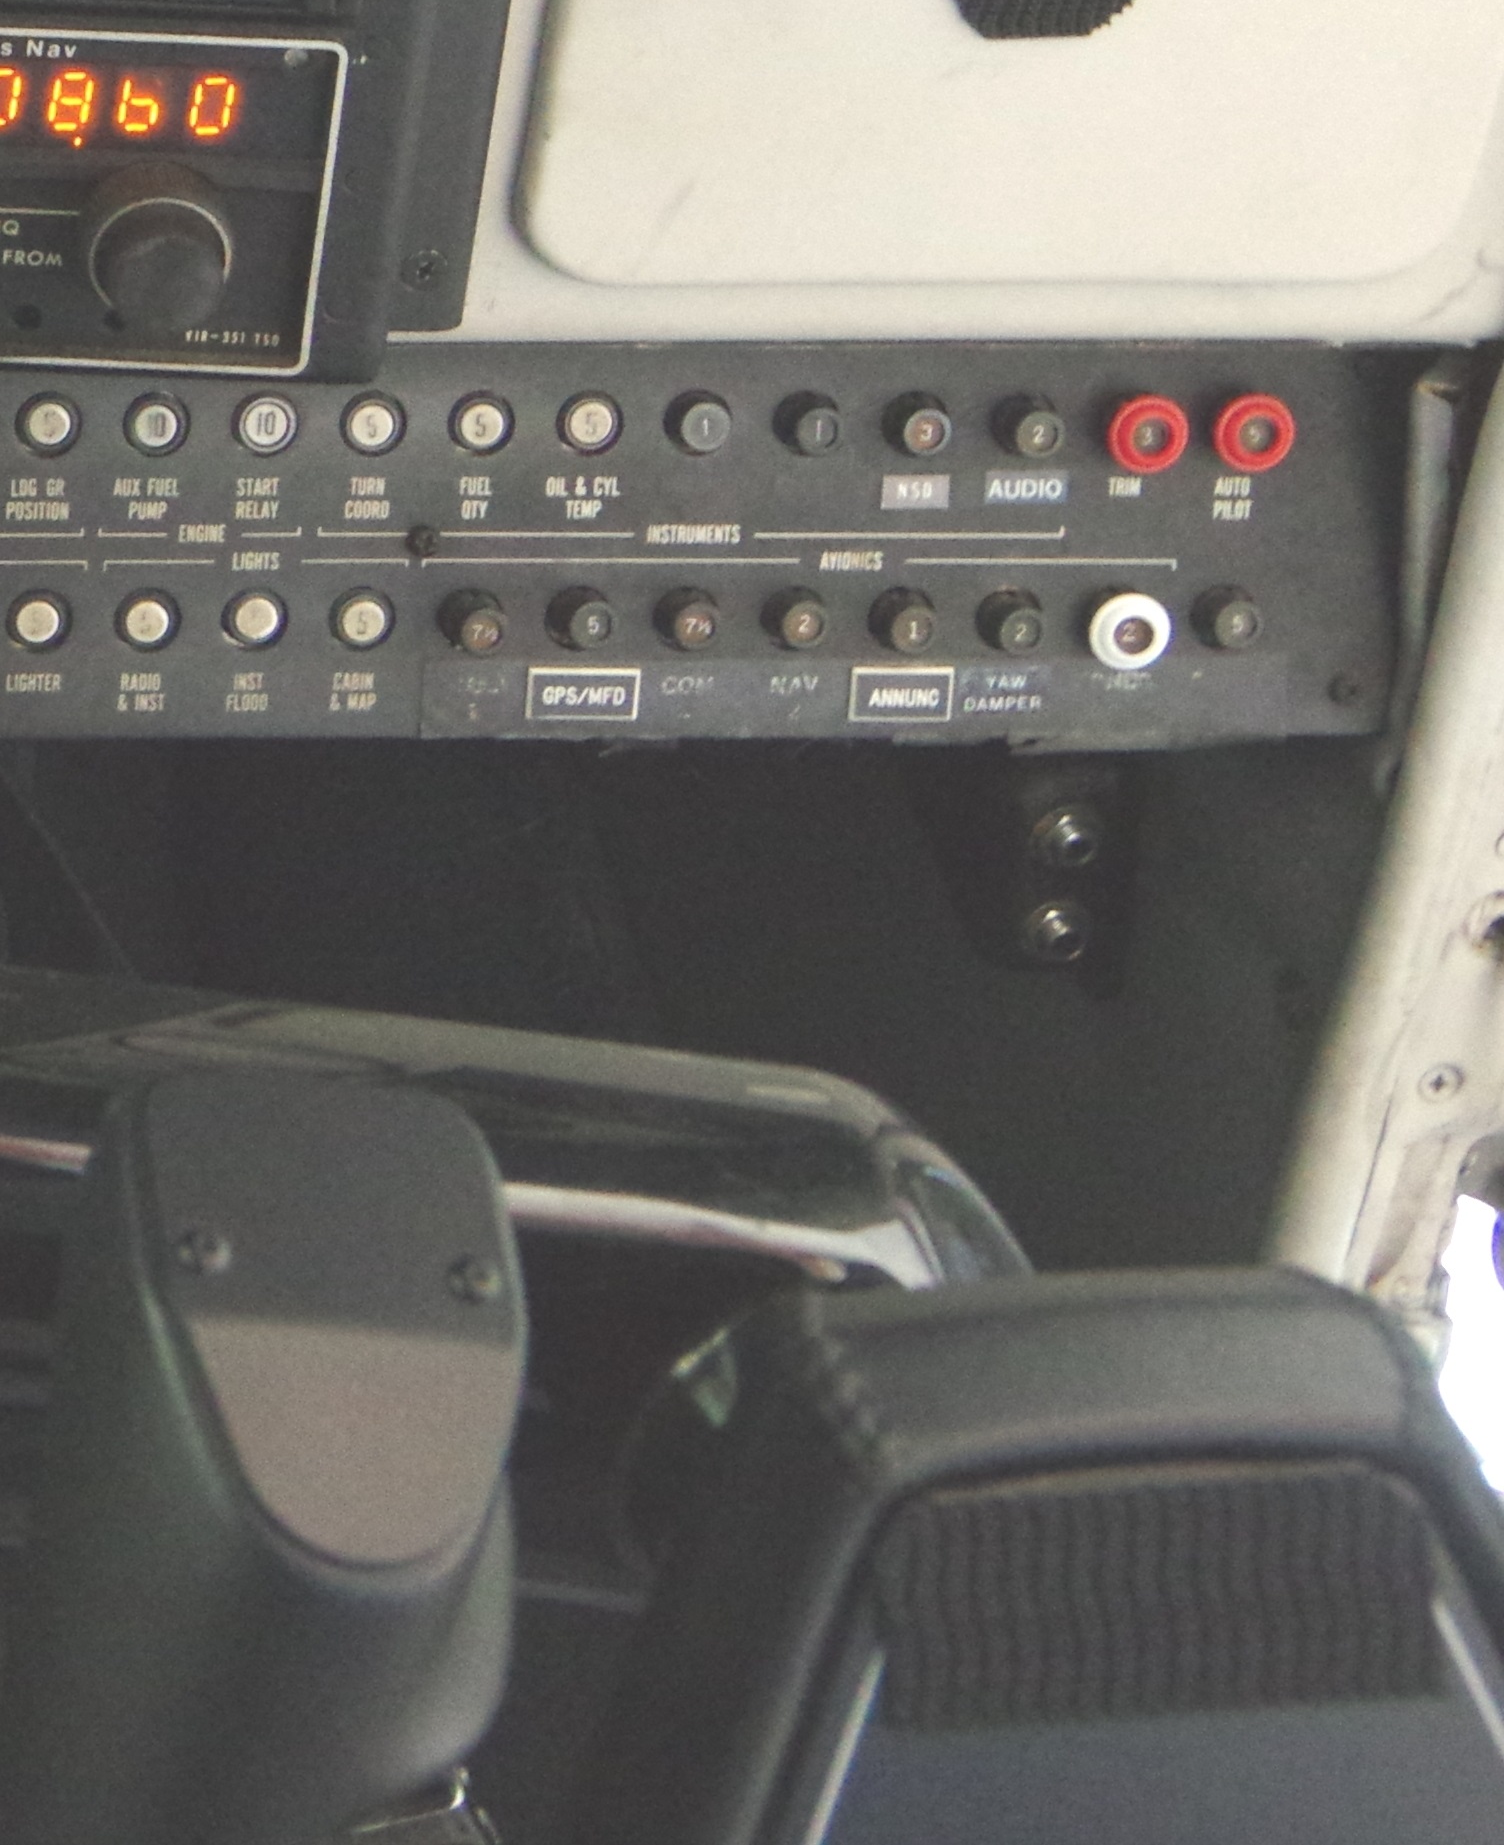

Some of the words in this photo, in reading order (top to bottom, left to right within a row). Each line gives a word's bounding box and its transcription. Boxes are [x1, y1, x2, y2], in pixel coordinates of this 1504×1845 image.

[26, 39, 77, 58] Nav
[2, 249, 62, 266] FROM
[988, 478, 1063, 500] AUDIO
[647, 524, 740, 545] INSTRUMENTS
[232, 552, 280, 571] LIGHTS
[542, 685, 626, 707] GPS/MFD
[869, 687, 940, 708] ANNUNC
